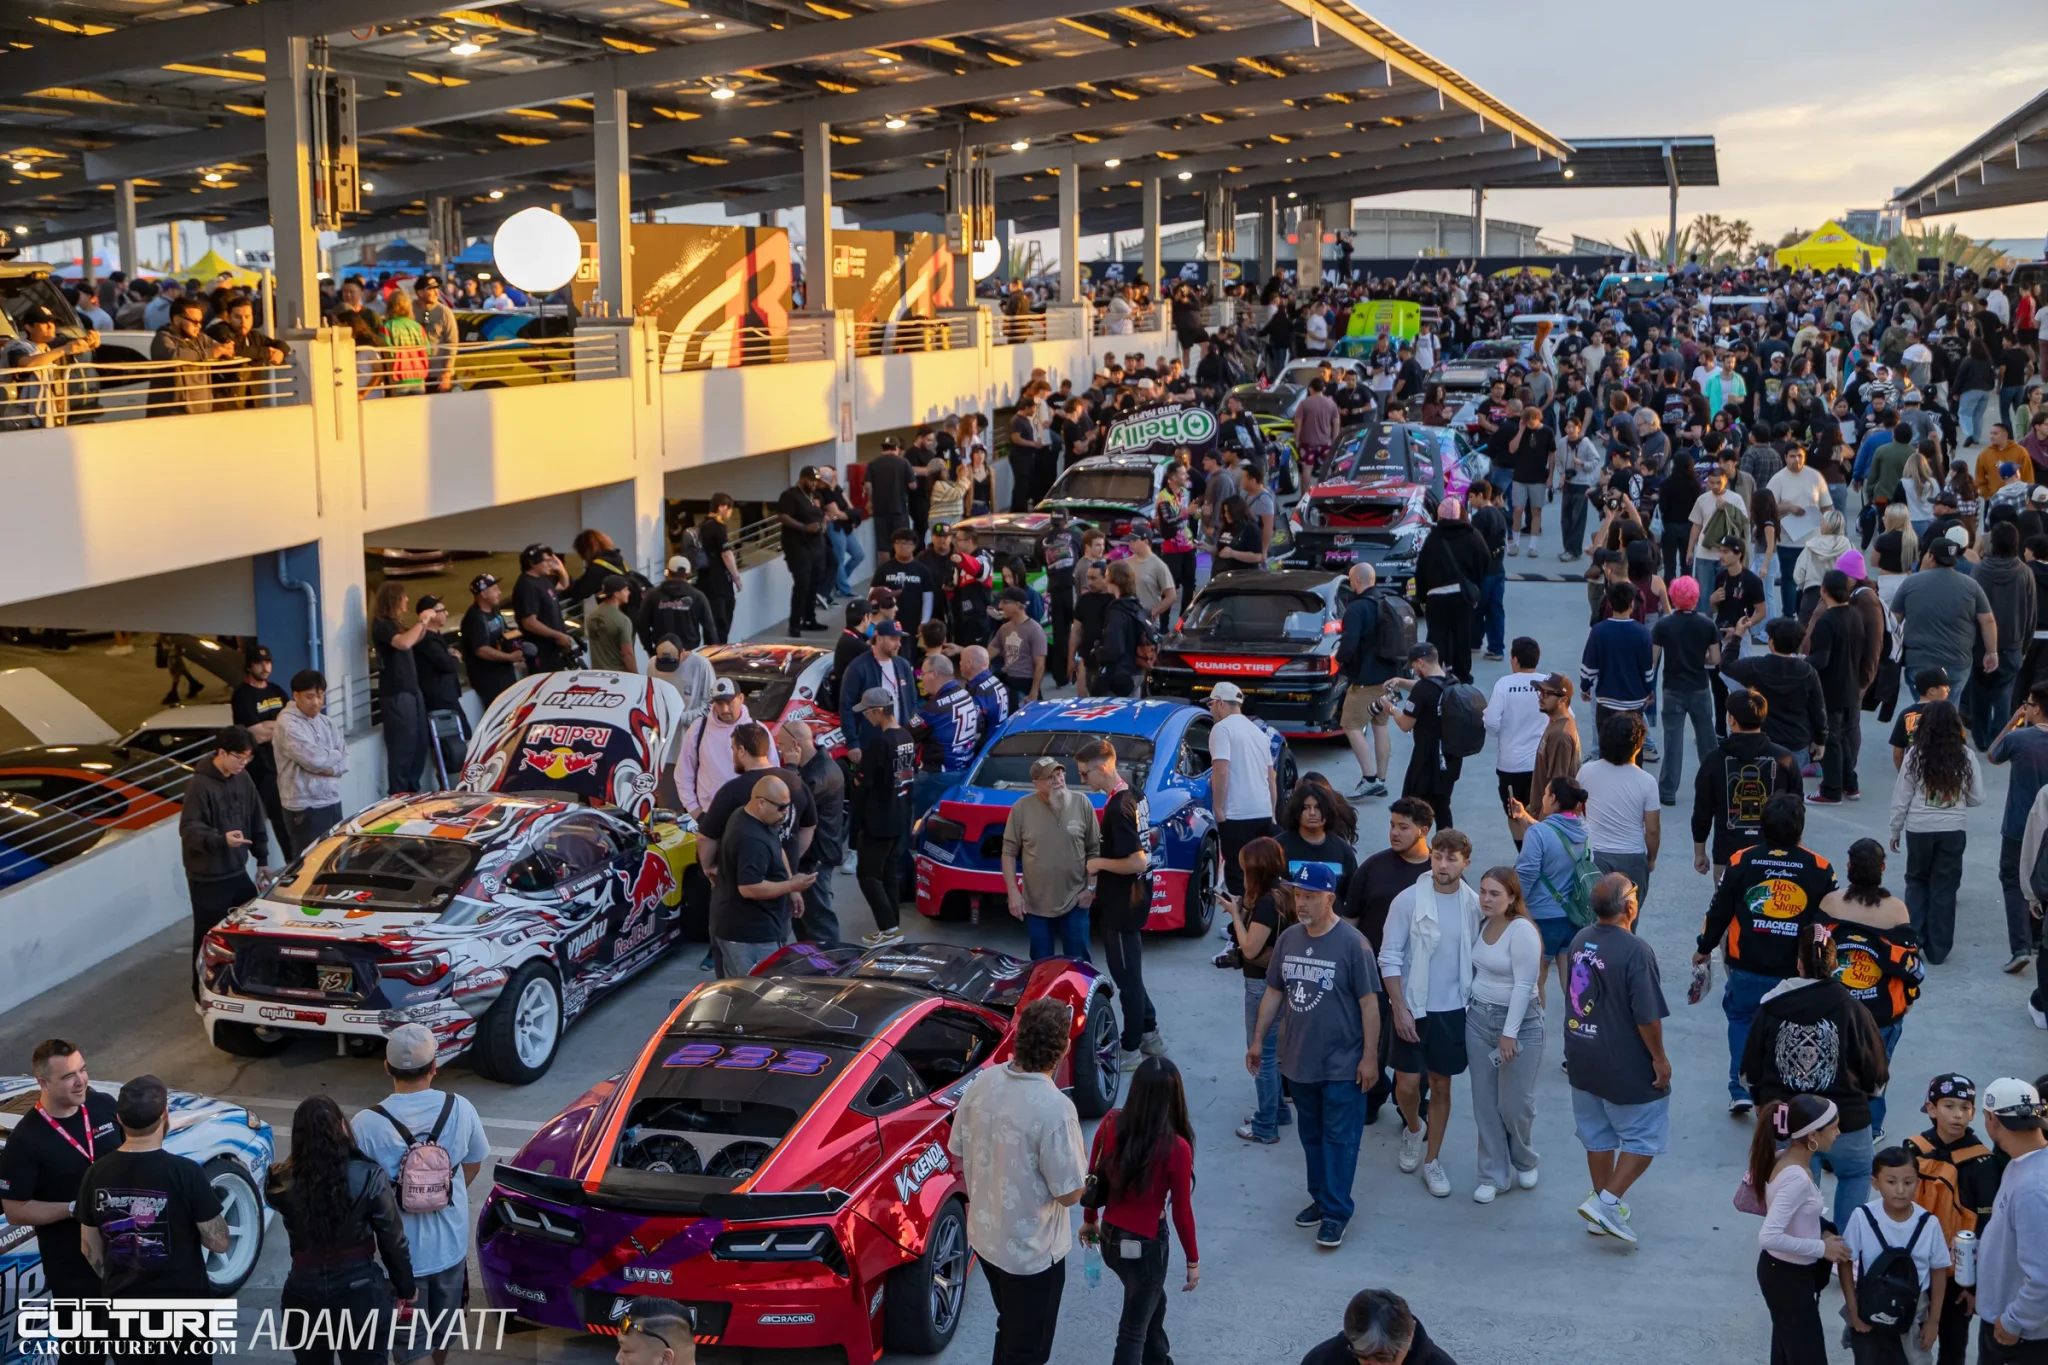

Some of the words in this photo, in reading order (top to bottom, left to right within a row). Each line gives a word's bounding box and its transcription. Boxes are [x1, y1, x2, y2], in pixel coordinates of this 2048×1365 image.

[1157, 403, 1182, 414] AUTO
[1107, 412, 1211, 447] O'Reilly
[1195, 661, 1241, 671] KUMHO
[1243, 663, 1274, 672] TIRE
[1058, 705, 1127, 721] 4
[1772, 879, 1797, 893] Bass
[1773, 890, 1791, 901] Pro
[1771, 899, 1802, 915] Shops
[1752, 919, 1799, 932] TRACKER
[1852, 961, 1871, 972] Pro
[1282, 962, 1335, 991] CHAMPS
[1850, 970, 1879, 985] Shops
[1294, 981, 1306, 1003] LA
[260, 1007, 296, 1020] enjuku
[661, 1043, 833, 1077] 233
[912, 1141, 946, 1183] KENDA
[408, 1186, 426, 1194] STEVE
[624, 1266, 673, 1284] LVRY
[504, 1283, 547, 1303] vibrant
[781, 1314, 814, 1323] RACING
